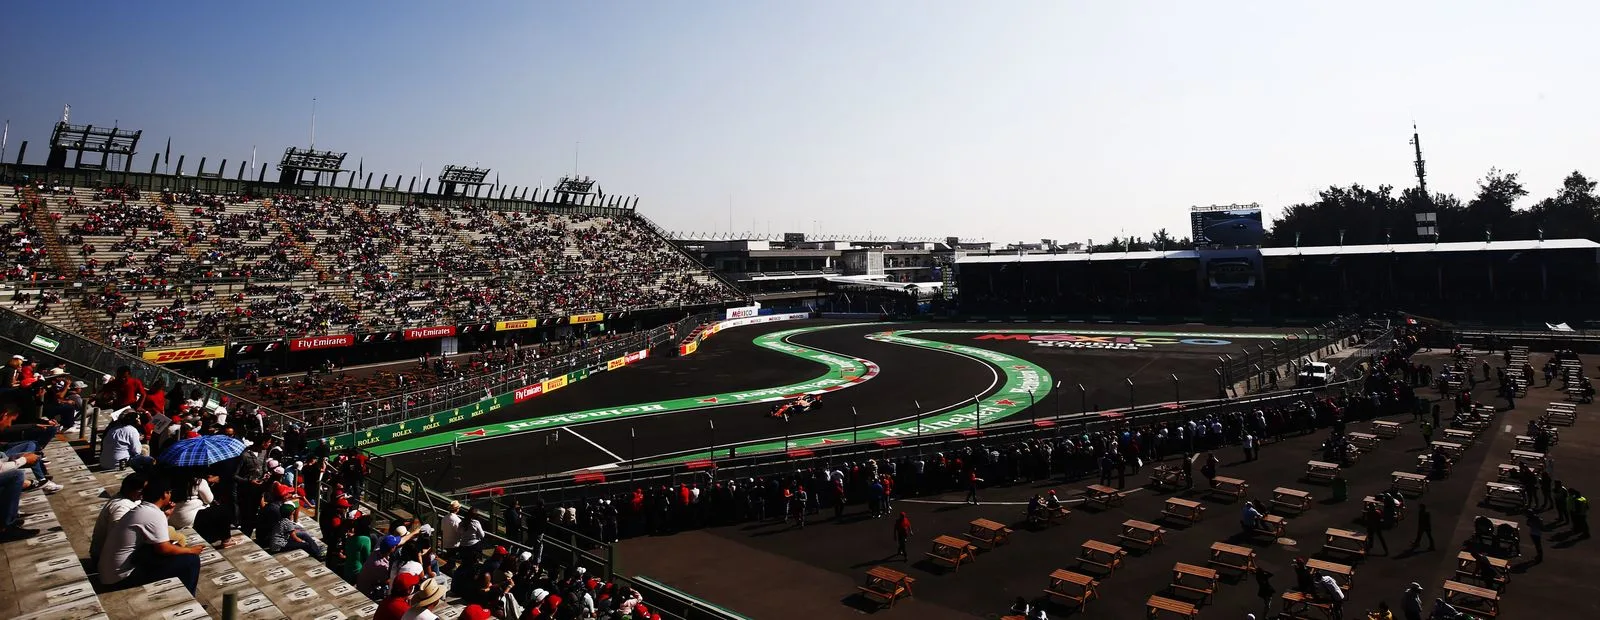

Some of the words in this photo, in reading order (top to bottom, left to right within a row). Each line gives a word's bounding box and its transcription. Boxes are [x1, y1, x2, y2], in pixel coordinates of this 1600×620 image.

[504, 321, 529, 329] PIRELLI
[411, 330, 423, 338] Fly
[423, 327, 450, 336] Emirates
[298, 340, 312, 348] Fly
[313, 336, 347, 347] Emirates
[156, 349, 206, 362] DHL
[515, 391, 524, 400] Fly
[471, 409, 484, 417] ROLEX
[504, 404, 667, 432] Heineken
[449, 414, 465, 423] ROLEX
[877, 404, 1007, 437] Heineken
[423, 421, 440, 431] ROLEX
[392, 428, 412, 438] ROLEX
[357, 436, 380, 447] ROLEX
